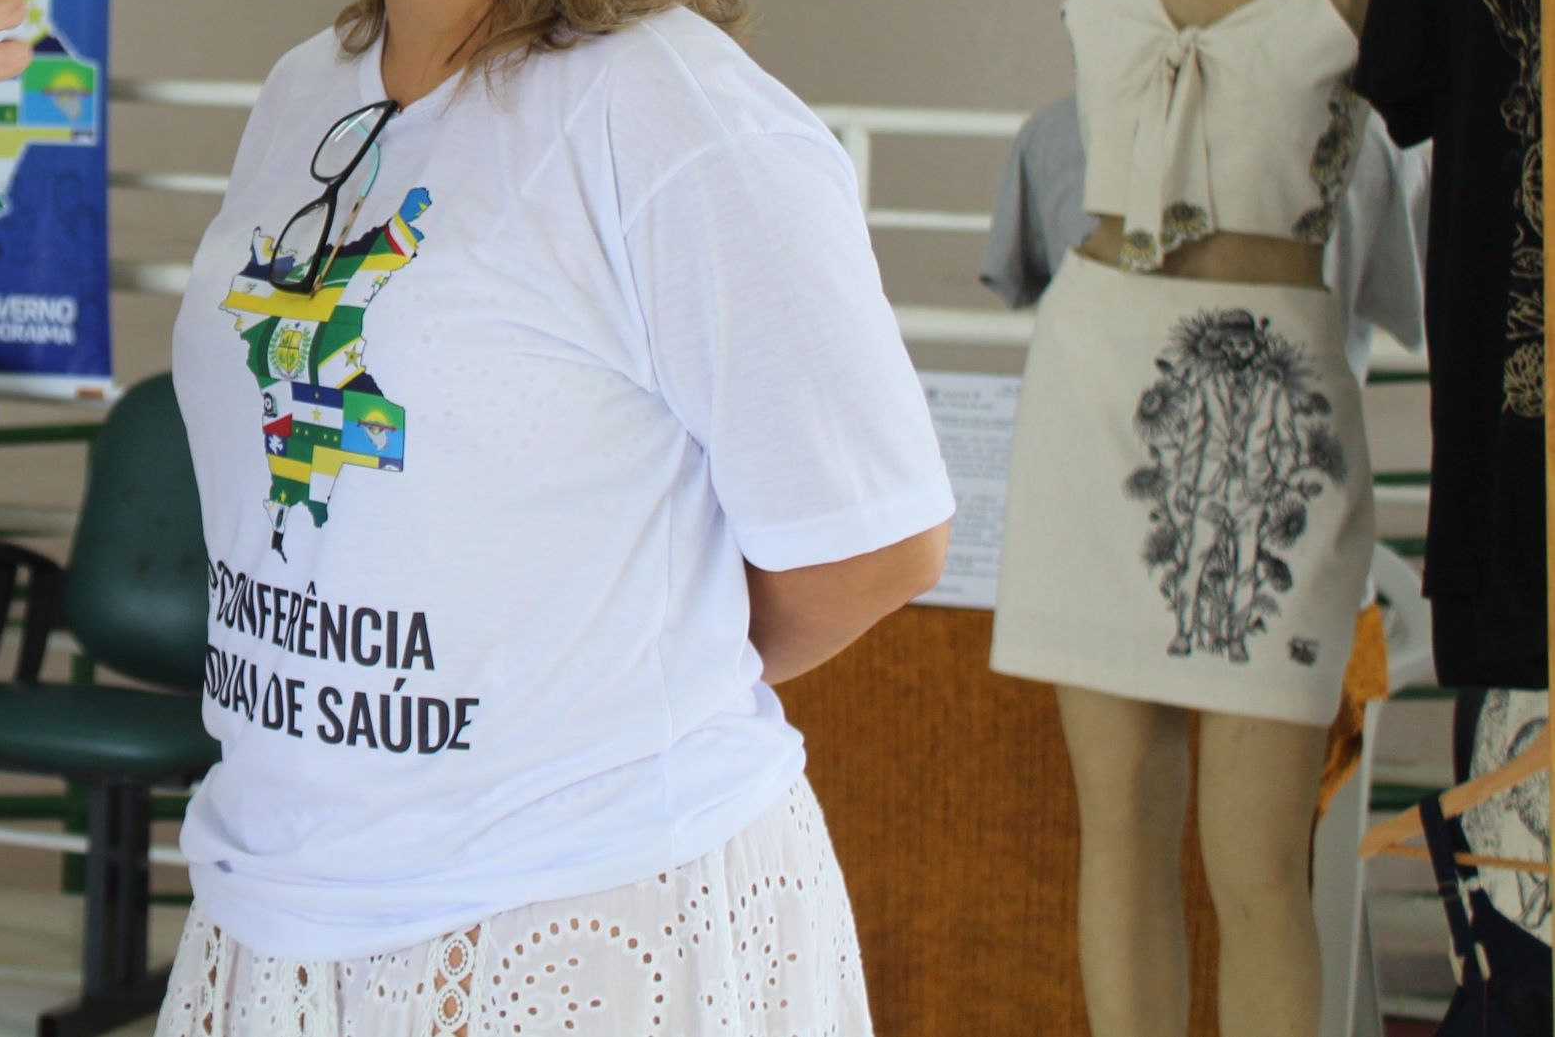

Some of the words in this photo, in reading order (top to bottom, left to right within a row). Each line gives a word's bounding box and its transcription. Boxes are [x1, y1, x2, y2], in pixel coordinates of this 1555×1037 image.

[216, 560, 435, 671] CONFERÊNCIA
[261, 672, 305, 738] DE
[317, 677, 479, 754] SAÚDE
